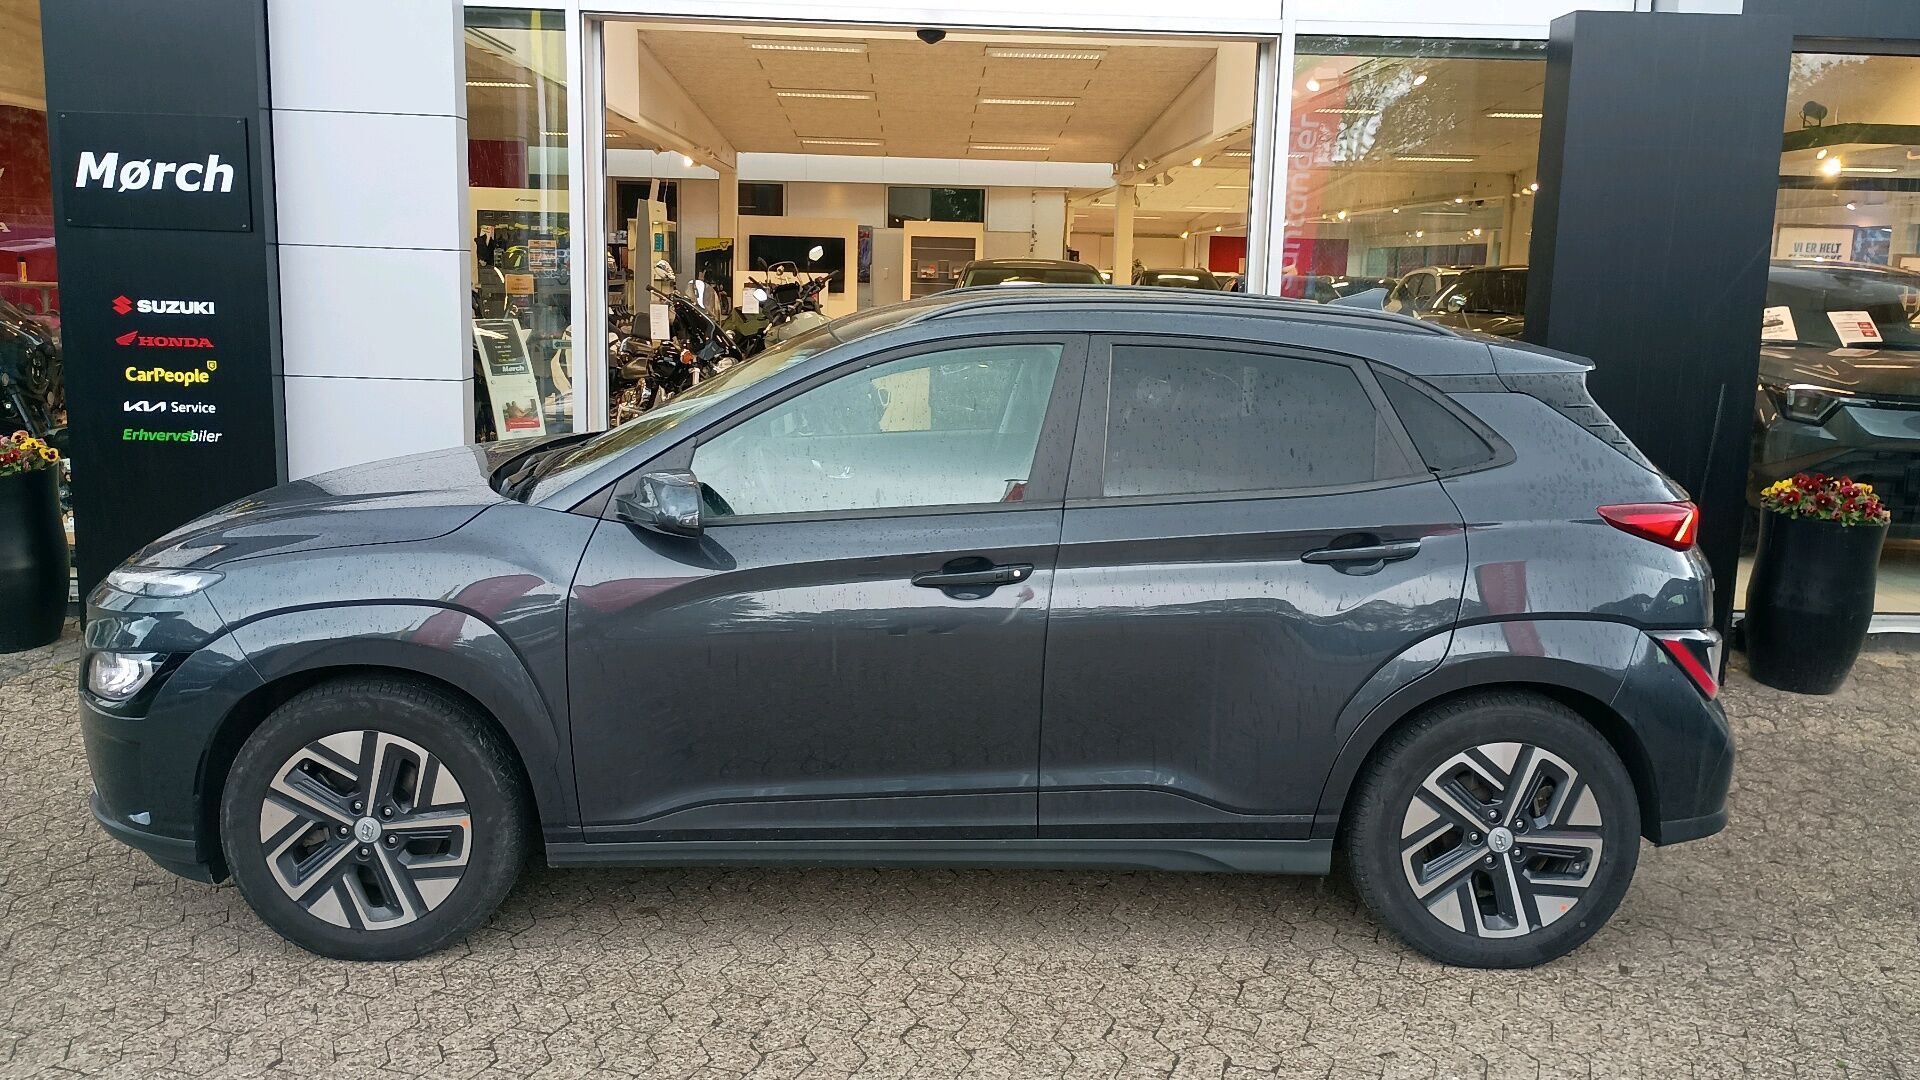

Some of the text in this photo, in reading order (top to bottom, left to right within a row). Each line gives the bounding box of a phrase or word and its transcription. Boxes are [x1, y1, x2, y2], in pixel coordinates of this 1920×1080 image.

[75, 151, 234, 193] Mørch
[1794, 242, 1842, 254] VI ER HELT
[137, 299, 215, 315] SUZUKI
[138, 336, 215, 348] HONDA
[125, 366, 210, 387] CarPeople
[123, 400, 216, 414] KIA Service
